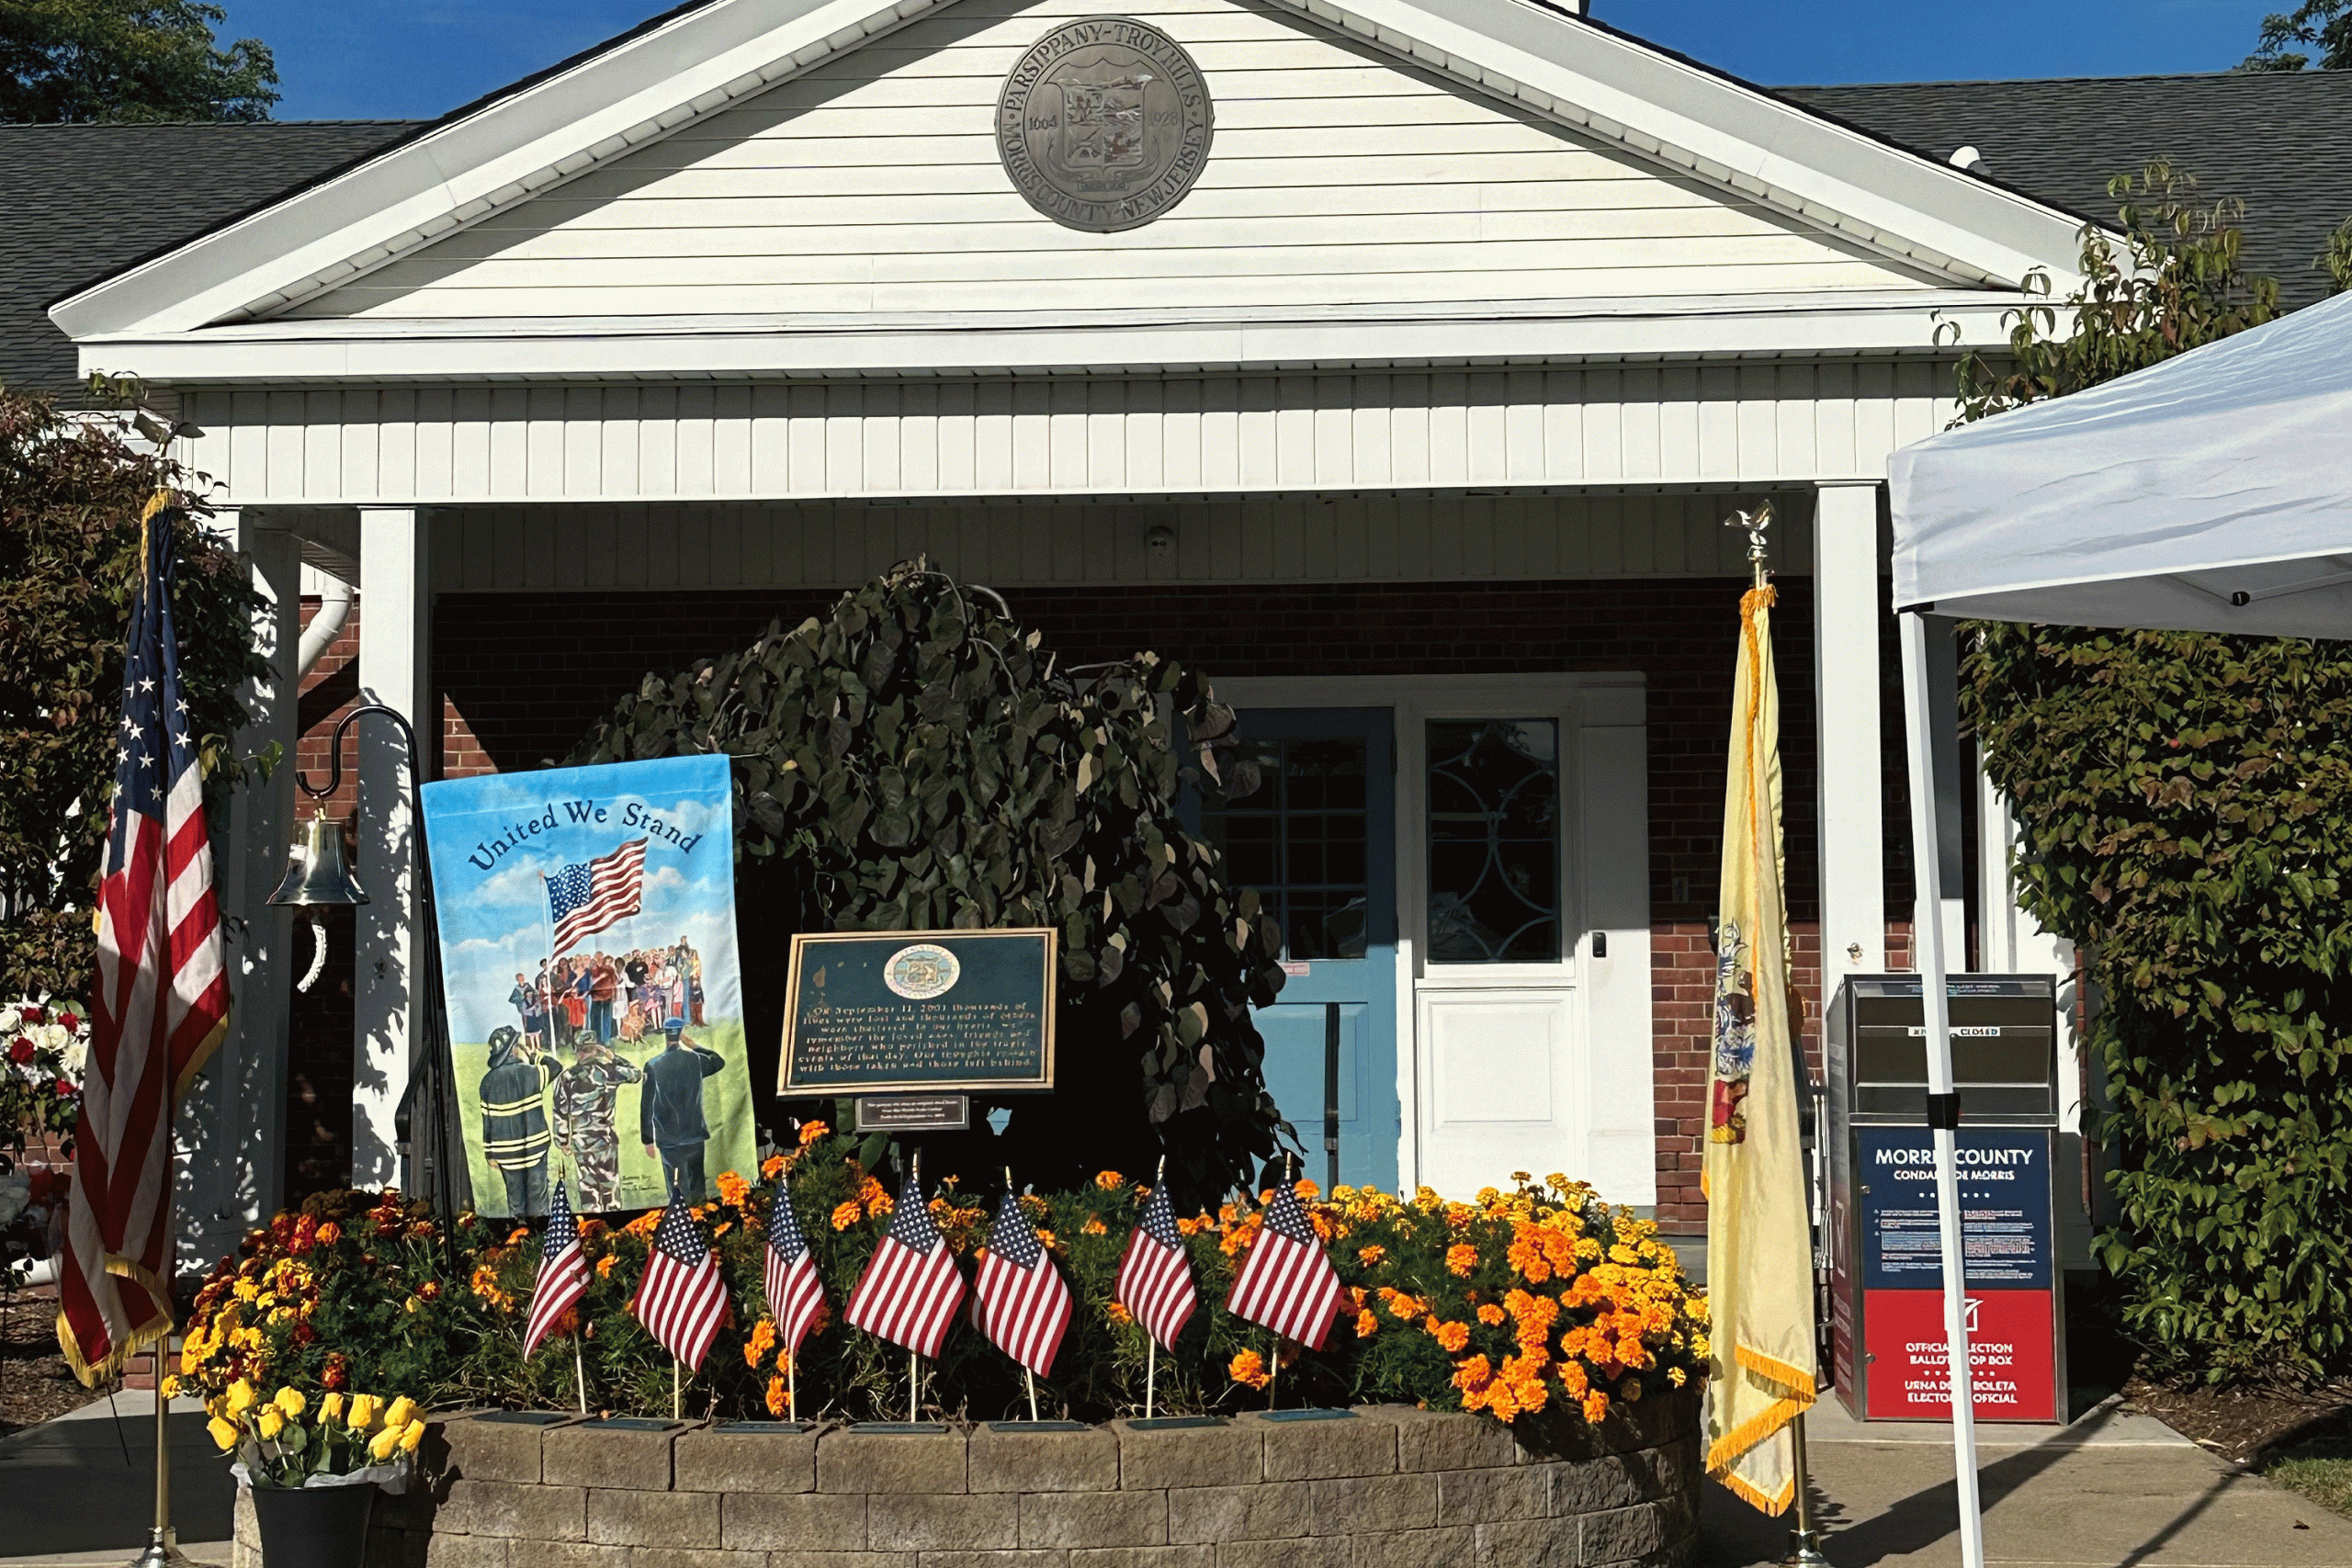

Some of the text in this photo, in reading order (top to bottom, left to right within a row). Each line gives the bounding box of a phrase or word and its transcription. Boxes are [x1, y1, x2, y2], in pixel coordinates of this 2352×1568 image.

[1005, 24, 1202, 111] PARSIPPANY-TROY HILLS
[1003, 123, 1042, 189] MORRIS
[1164, 120, 1204, 196] JERSEY
[468, 799, 704, 871] United We Stand
[835, 1005, 895, 1016] September
[953, 1003, 1009, 1011] thousands
[1014, 1001, 1027, 1010] of
[837, 1016, 864, 1024] were
[921, 1012, 977, 1021] thousands
[982, 1011, 995, 1020] of
[806, 1035, 863, 1043] remember
[871, 1043, 894, 1051] who
[840, 1053, 853, 1061] of
[799, 1064, 824, 1072] with
[866, 1062, 897, 1070] taken
[902, 1060, 923, 1068] and
[1875, 1149, 2033, 1165] MORRI COUNTY
[1894, 1170, 1938, 1180] CONDA
[1971, 1170, 2015, 1180] MORRIS
[1905, 1343, 2013, 1353] OFFICIA ECTION
[1988, 1356, 2013, 1365] BOX
[1905, 1381, 1937, 1391] URNA
[1973, 1381, 2017, 1391] BOLETA
[1973, 1393, 2018, 1404] OFICIAL
